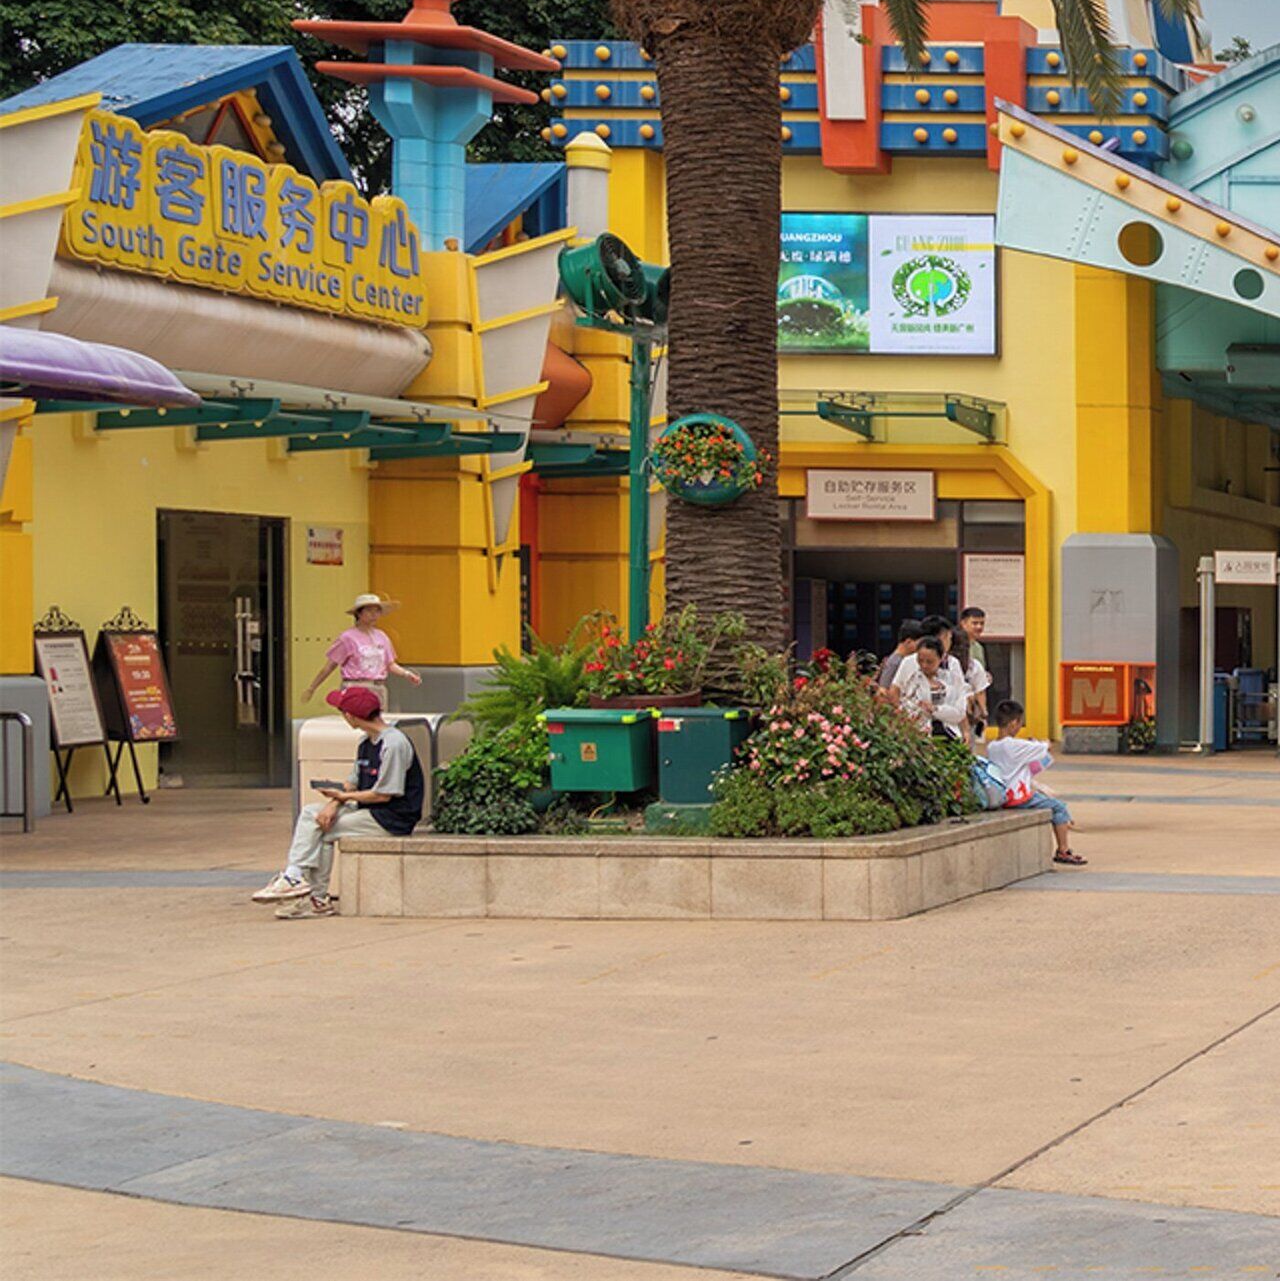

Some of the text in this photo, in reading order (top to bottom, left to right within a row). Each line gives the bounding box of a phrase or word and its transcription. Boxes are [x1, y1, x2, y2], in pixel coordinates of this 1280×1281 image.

[90, 119, 420, 278] 游客服务中心
[82, 210, 425, 316] South Gate Service Center
[780, 233, 842, 243] UANGZHOU
[1071, 678, 1117, 714] M
